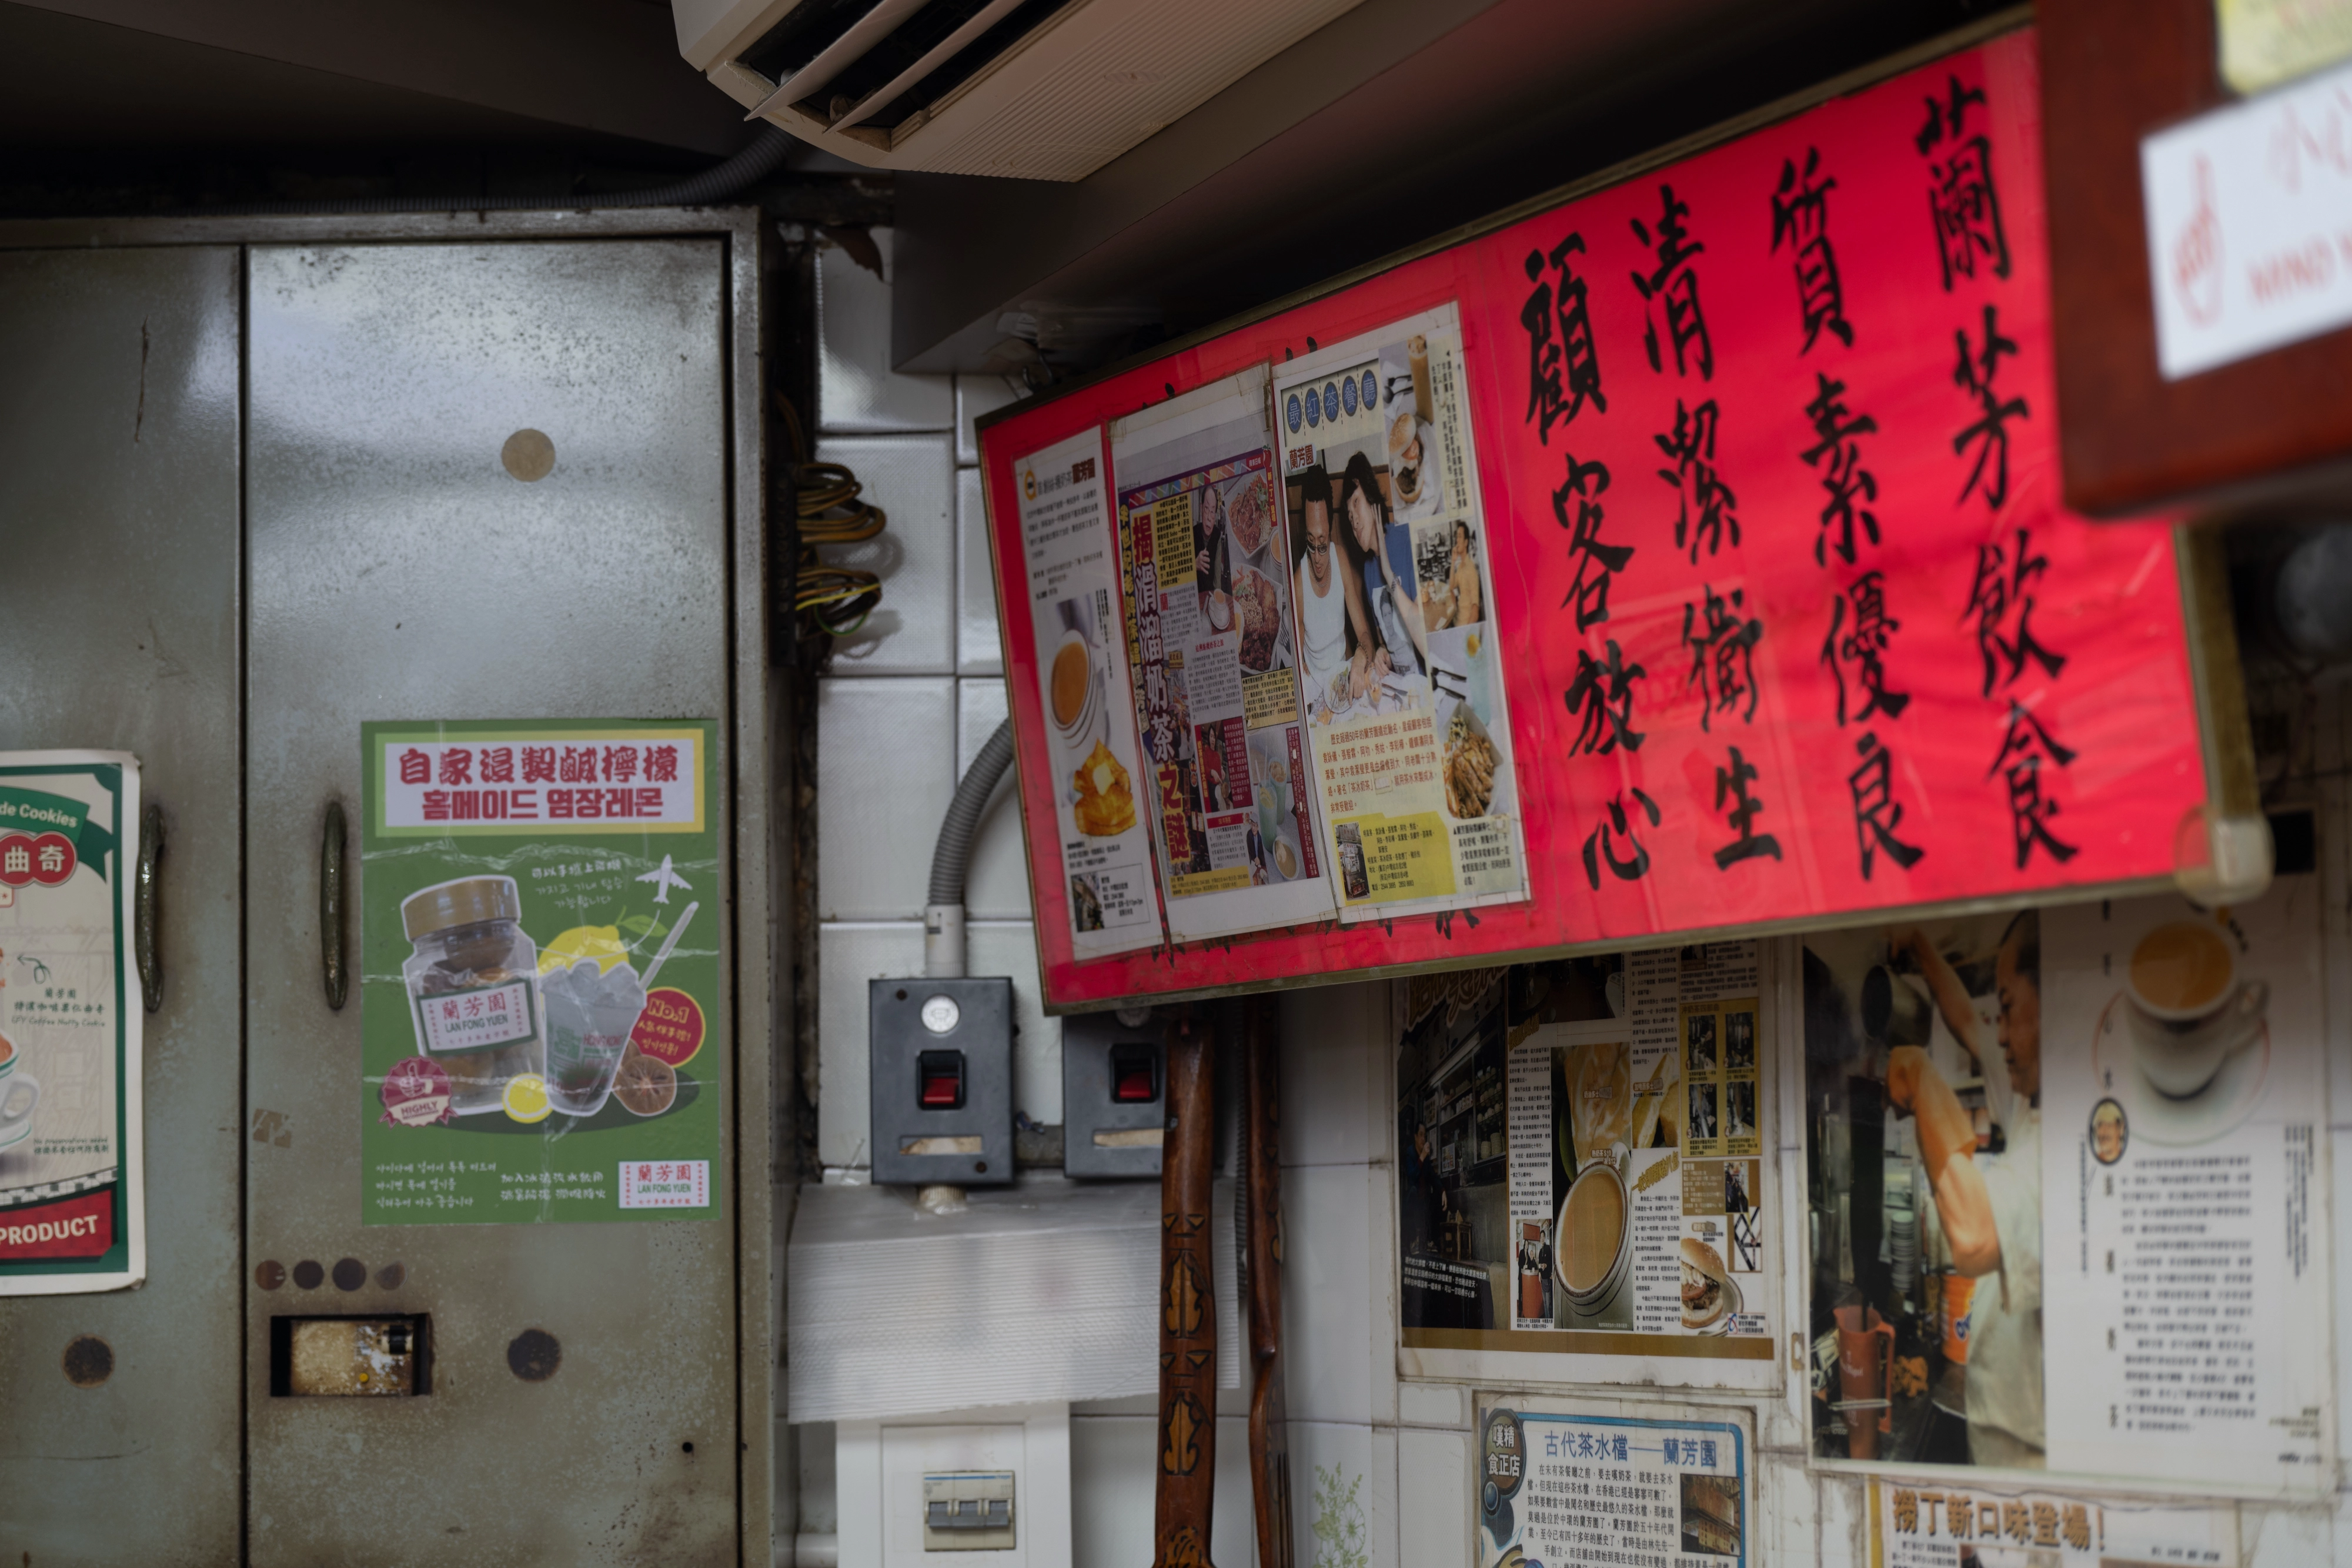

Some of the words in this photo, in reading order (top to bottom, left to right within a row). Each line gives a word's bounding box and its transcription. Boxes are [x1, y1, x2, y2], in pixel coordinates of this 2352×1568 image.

[1288, 377, 1376, 425] 最紅茶餐廳
[1289, 444, 1314, 470] 蘭芳園
[1914, 73, 2082, 872] 蘭芳飲食
[1772, 147, 1926, 882] 質素優良
[1521, 230, 1662, 893] 顧客放心
[1129, 510, 1190, 867] 揭滑溜奶茶之謎
[19, 804, 78, 828] Cookies
[423, 789, 539, 821] 홈메이드
[547, 788, 663, 819] 염장레몬
[4, 844, 65, 874] 曲奇
[534, 884, 570, 895] 가지고
[573, 882, 597, 891] 기내
[600, 876, 624, 891] 탑승
[554, 894, 612, 910] 가능합니다
[44, 987, 76, 999] 蘭芳園
[442, 992, 507, 1021] 蘭芳園
[647, 997, 690, 1024] No.1
[29, 1017, 55, 1026] Coffee
[445, 1021, 461, 1034] LAN
[463, 1018, 485, 1031] FONG
[486, 1014, 509, 1026] YUEN
[401, 1101, 437, 1115] HIGHLY
[638, 1164, 691, 1182] 蘭芳園
[637, 1184, 652, 1193] LAN
[652, 1184, 671, 1193] FONG
[673, 1183, 691, 1193] YUEN
[1492, 1423, 1515, 1447] 嘆精
[1488, 1454, 1521, 1477] 食正店
